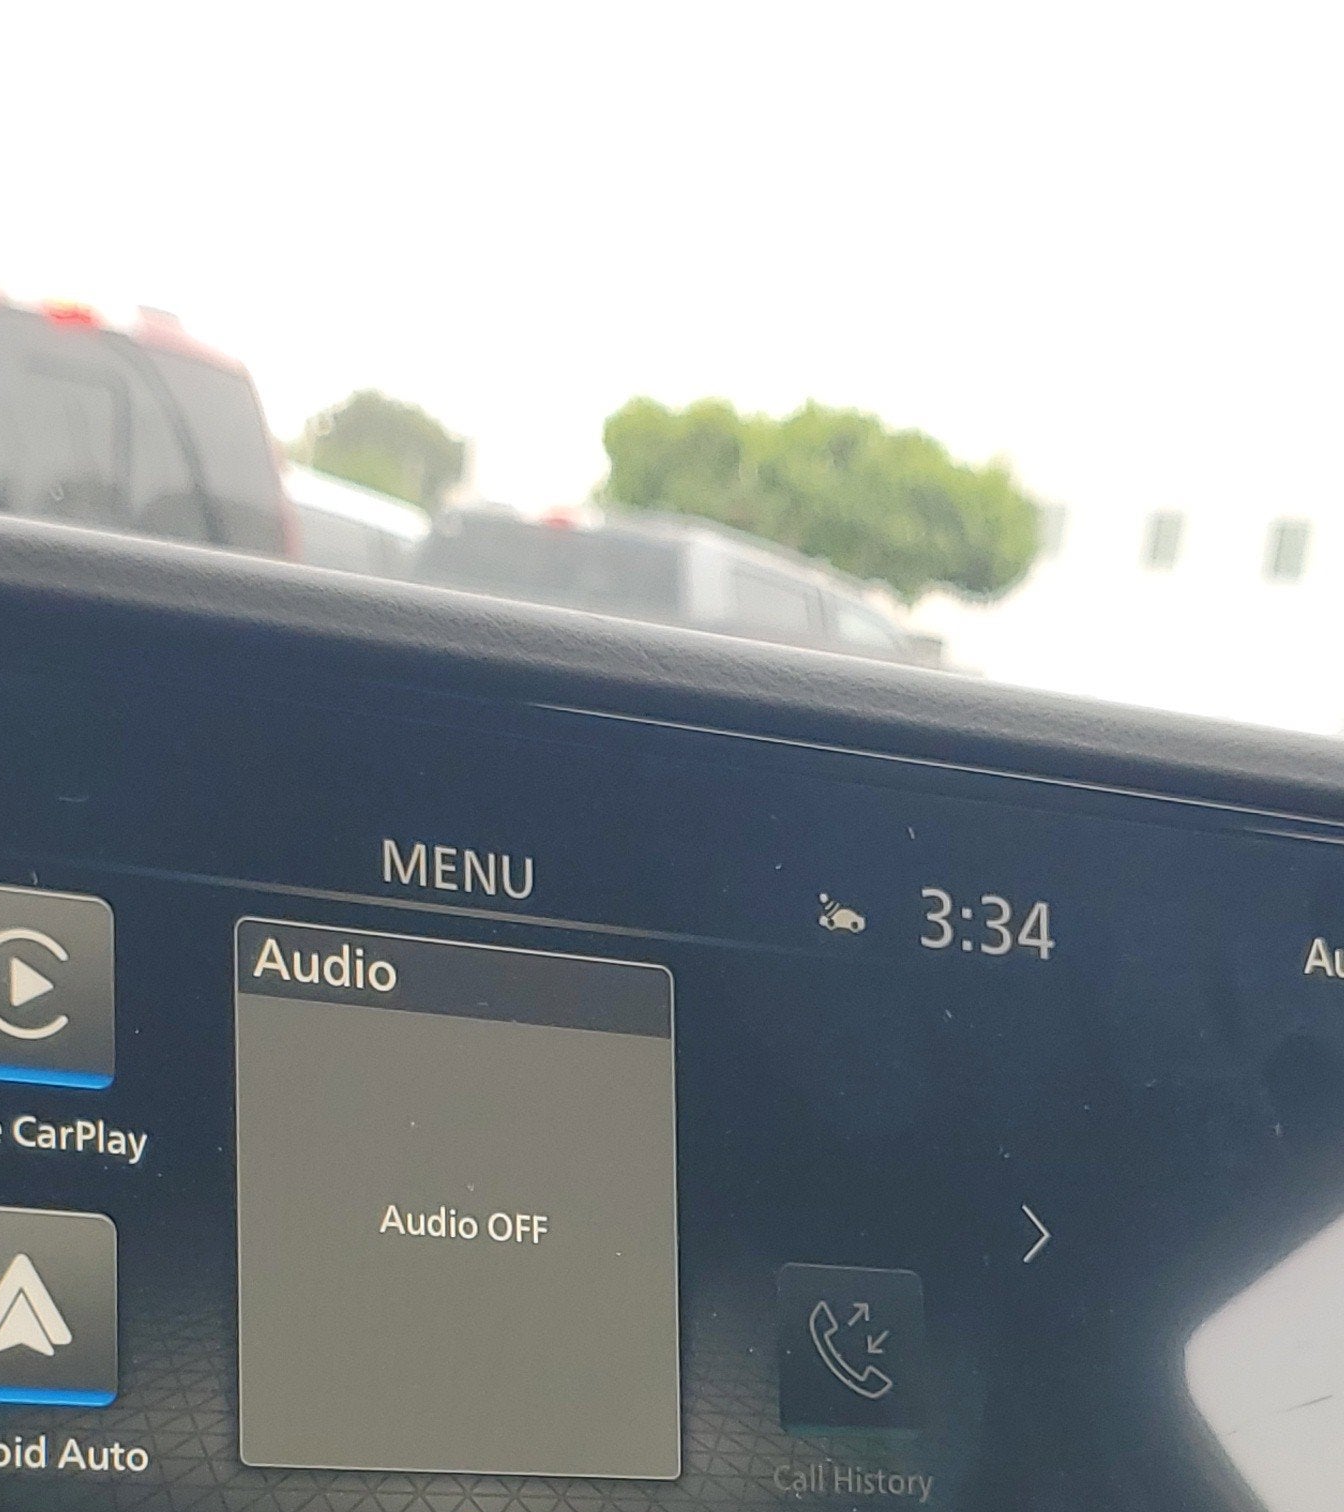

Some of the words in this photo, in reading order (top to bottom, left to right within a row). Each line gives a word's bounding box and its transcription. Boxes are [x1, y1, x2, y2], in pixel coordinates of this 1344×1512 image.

[381, 839, 534, 900] MENU
[920, 889, 1055, 959] 3:34
[252, 936, 399, 993] Audio
[12, 1116, 148, 1163] CarPlay
[379, 1205, 478, 1241] Audio
[487, 1211, 548, 1245] OFF
[57, 1437, 149, 1472] Auto
[772, 1464, 824, 1492] Call
[833, 1465, 933, 1503] History
